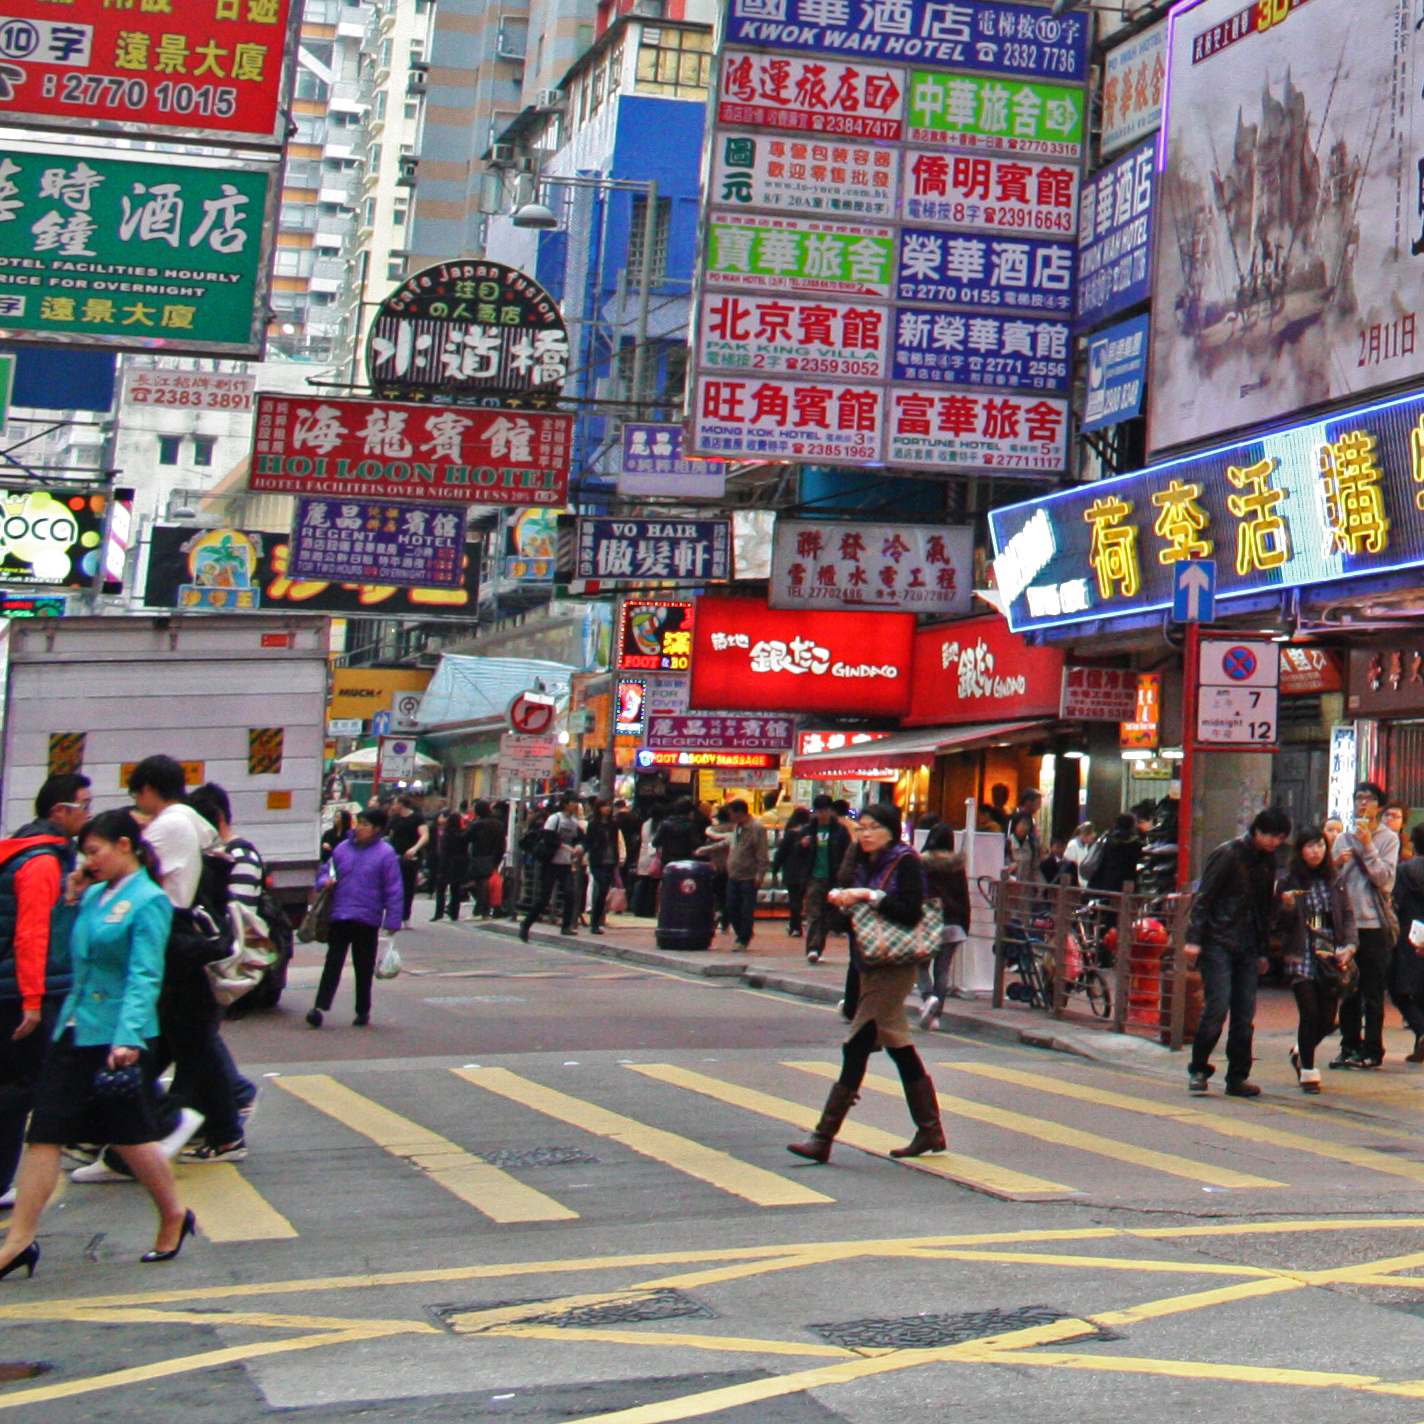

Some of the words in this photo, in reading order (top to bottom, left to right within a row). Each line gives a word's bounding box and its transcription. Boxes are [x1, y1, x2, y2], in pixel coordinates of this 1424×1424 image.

[114, 30, 268, 82] 遠景大廈
[739, 21, 820, 46] KWOK
[823, 30, 882, 52] WAH
[884, 36, 965, 61] HOTEL
[1003, 42, 1037, 69] 2332
[1043, 46, 1076, 73] 7736
[155, 81, 238, 118] 1015
[913, 74, 1042, 137] 中華旅舍
[912, 154, 1075, 208] 僑明賓館
[118, 182, 250, 255] 酒店
[998, 206, 1072, 232] 23916643
[52, 260, 158, 277] FACILITIES
[164, 268, 242, 284] HOURLY
[714, 227, 888, 282] 寶華旅舍
[901, 233, 1073, 290] 榮華酒店
[50, 277, 88, 289] FOR
[93, 279, 207, 298] OVERNIGHT
[389, 276, 432, 311] Cafe
[454, 280, 499, 301] 注目
[917, 284, 957, 301] 2770
[961, 287, 1000, 305] 0155
[40, 295, 197, 330] 遠景大廈
[709, 297, 882, 351] 北京賓館
[706, 341, 750, 352] PAK
[757, 344, 809, 356] KING
[817, 348, 878, 359] VILLA
[898, 311, 1069, 360] 新榮華賓館
[1356, 314, 1417, 368] 2月11日
[371, 325, 569, 387] 水道橋
[800, 357, 839, 373] 2359
[841, 360, 879, 376] 3052
[985, 359, 1022, 374] 2771
[1028, 361, 1067, 377] 2556
[153, 388, 203, 407] 2383
[206, 391, 251, 409] 3891
[703, 380, 878, 432] 旺角賓館
[291, 405, 536, 465] 海龍賓館
[701, 425, 743, 436] MONG
[747, 427, 775, 438] KOK
[779, 430, 821, 441] HOTEL
[895, 392, 1063, 443] 富華旅舍
[893, 437, 957, 448] FORTUNE
[960, 440, 1002, 451] HOTEL
[254, 477, 301, 490] HOTEL
[387, 482, 424, 496] OVER
[427, 485, 471, 499] NIGHT
[474, 489, 508, 501] LESS
[256, 453, 328, 478] HOI
[335, 456, 435, 484] LOON
[443, 464, 563, 491] HOTEL
[301, 527, 377, 542] REGENT
[398, 533, 455, 548] HOTEL
[611, 523, 638, 537] VO
[646, 524, 698, 538] HAIR
[597, 539, 711, 577] 傲髮軒
[749, 635, 832, 675] 銀だこ
[831, 662, 898, 678] GINDACO
[1248, 691, 1262, 709] 7
[732, 737, 789, 748] HOTEL
[1201, 719, 1243, 729] midnight
[1248, 721, 1272, 740] 12
